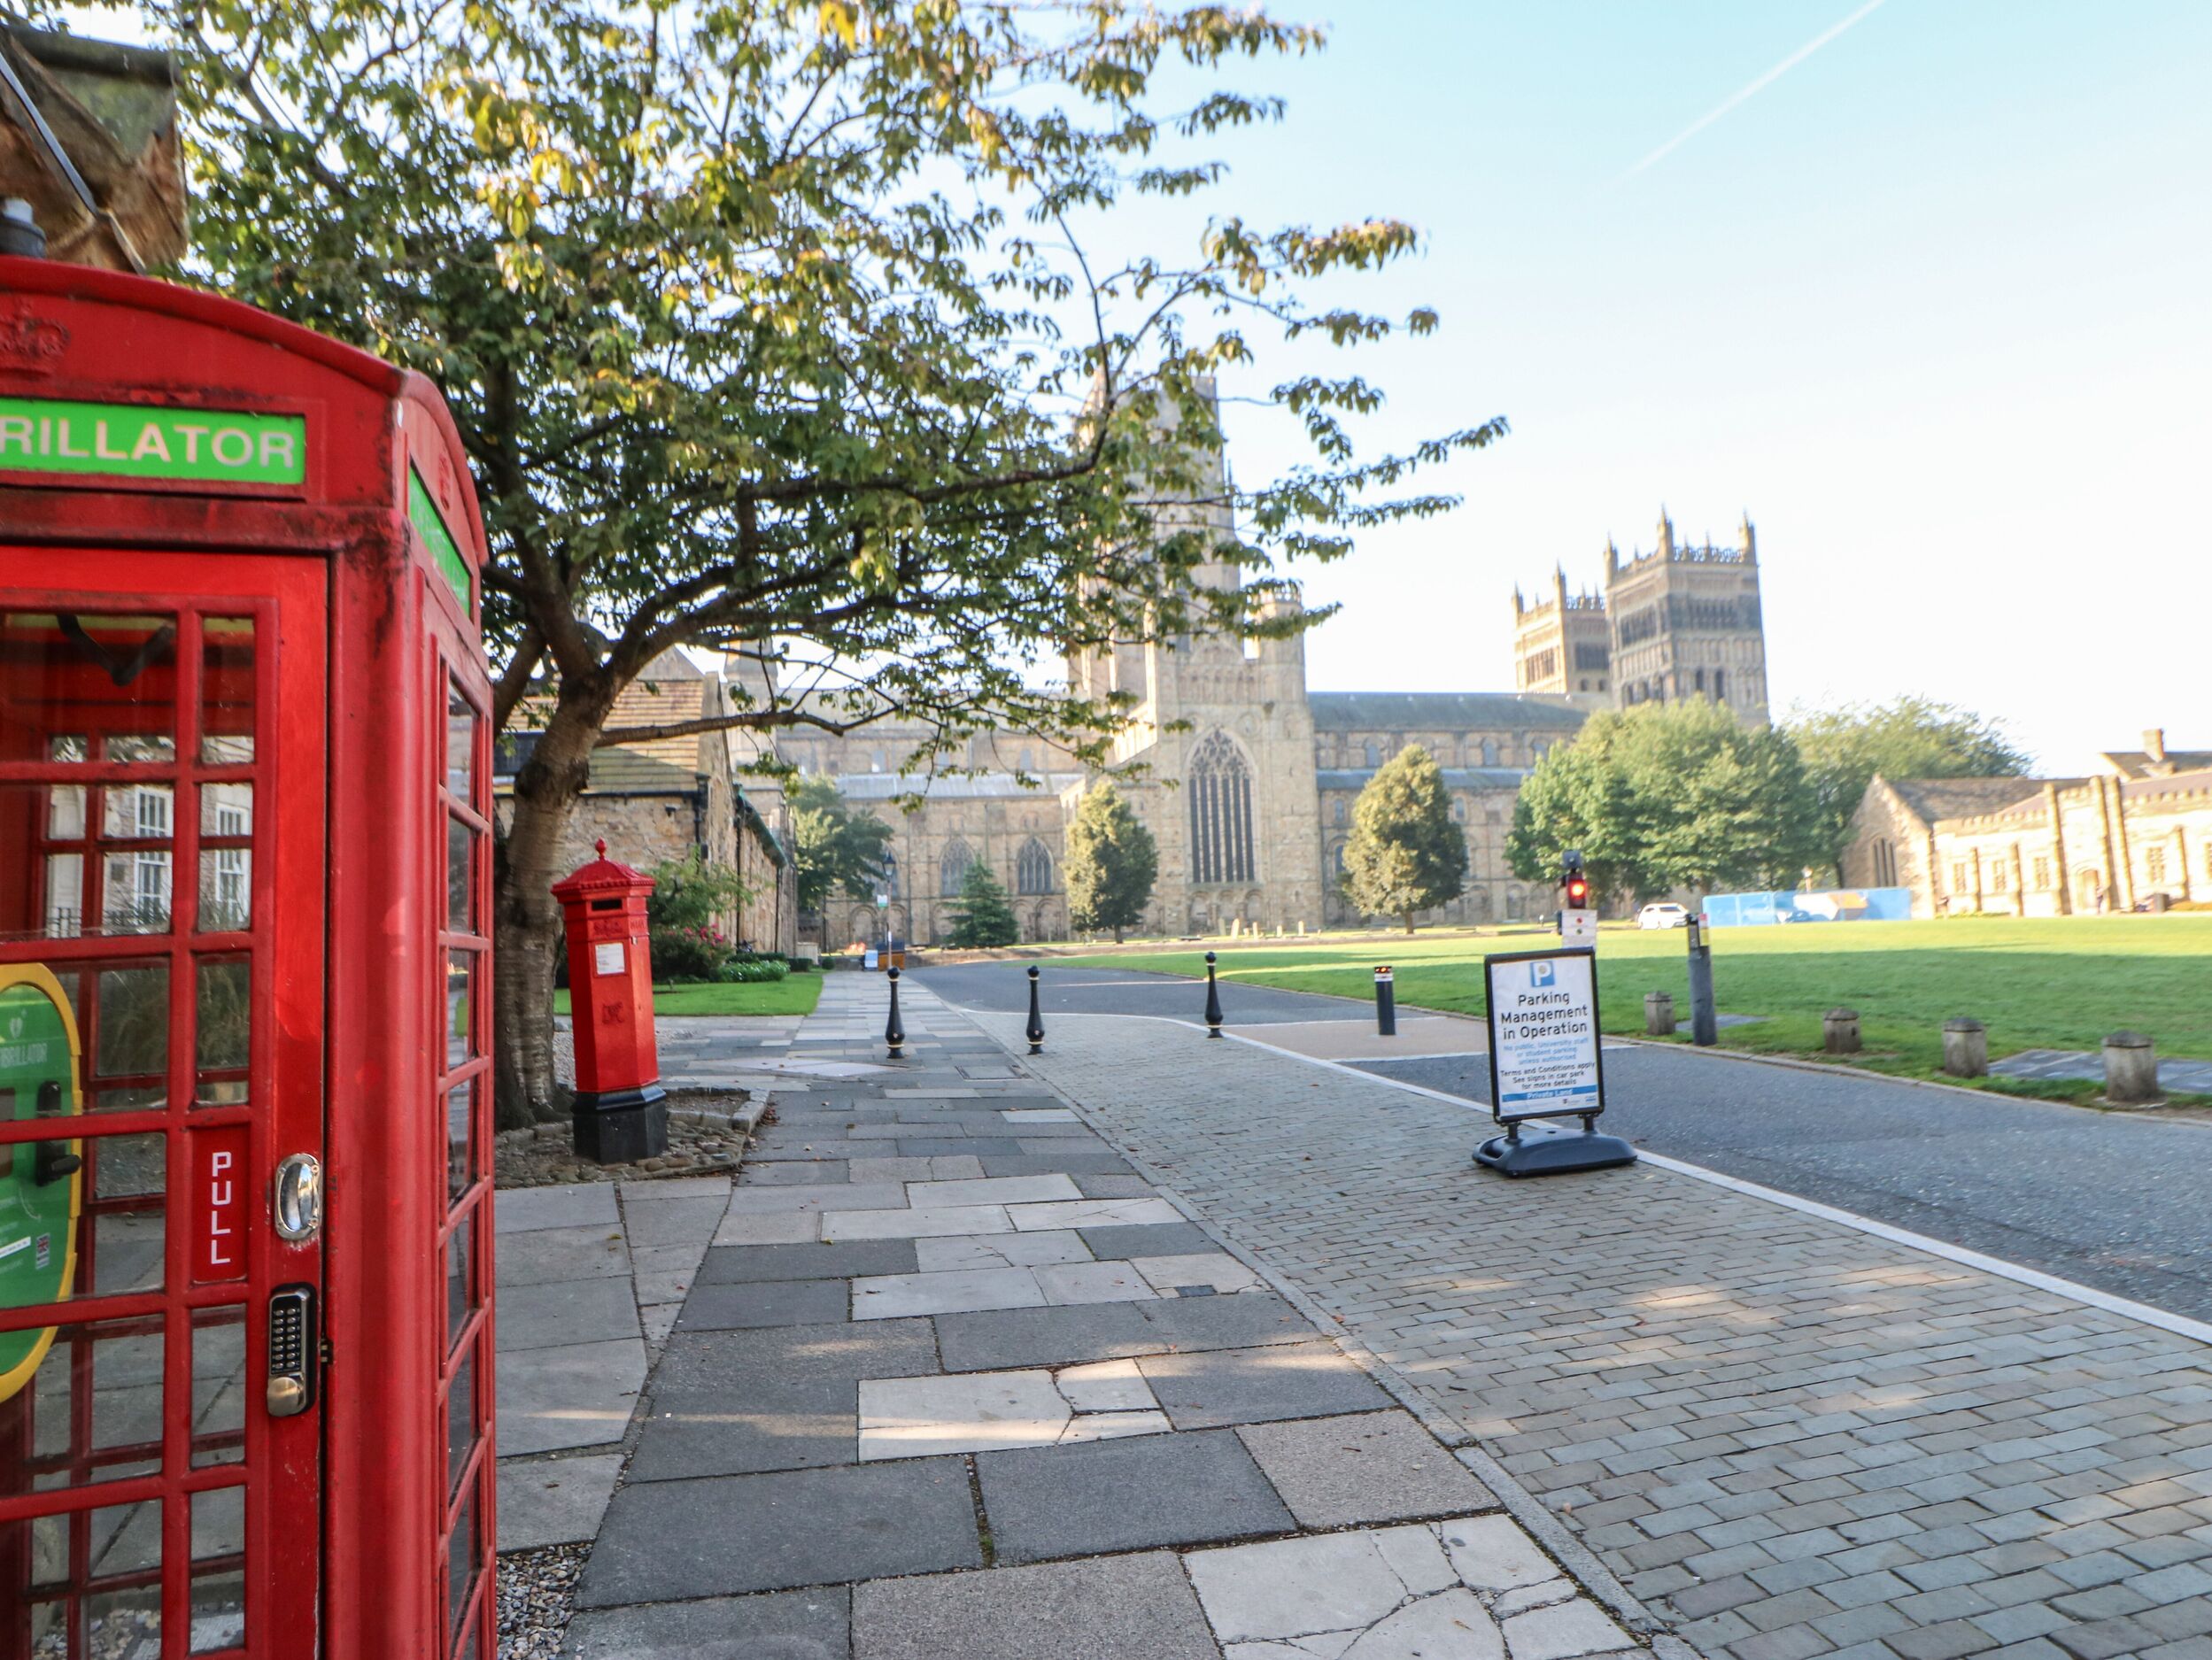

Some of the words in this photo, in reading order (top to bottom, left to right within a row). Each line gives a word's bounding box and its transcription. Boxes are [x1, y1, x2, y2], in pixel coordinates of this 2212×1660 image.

[1519, 992, 1570, 1007] Parking
[1501, 1005, 1588, 1024] Management
[1504, 1028, 1515, 1040] in
[1520, 1022, 1588, 1039] Operation
[1538, 1063, 1576, 1073] Conditions
[1578, 1062, 1596, 1070] apply
[1528, 1074, 1546, 1083] signs
[1570, 1069, 1585, 1078] park
[1527, 1090, 1556, 1100] Private
[1558, 1087, 1574, 1097] Land
[211, 1151, 232, 1265] PULL
